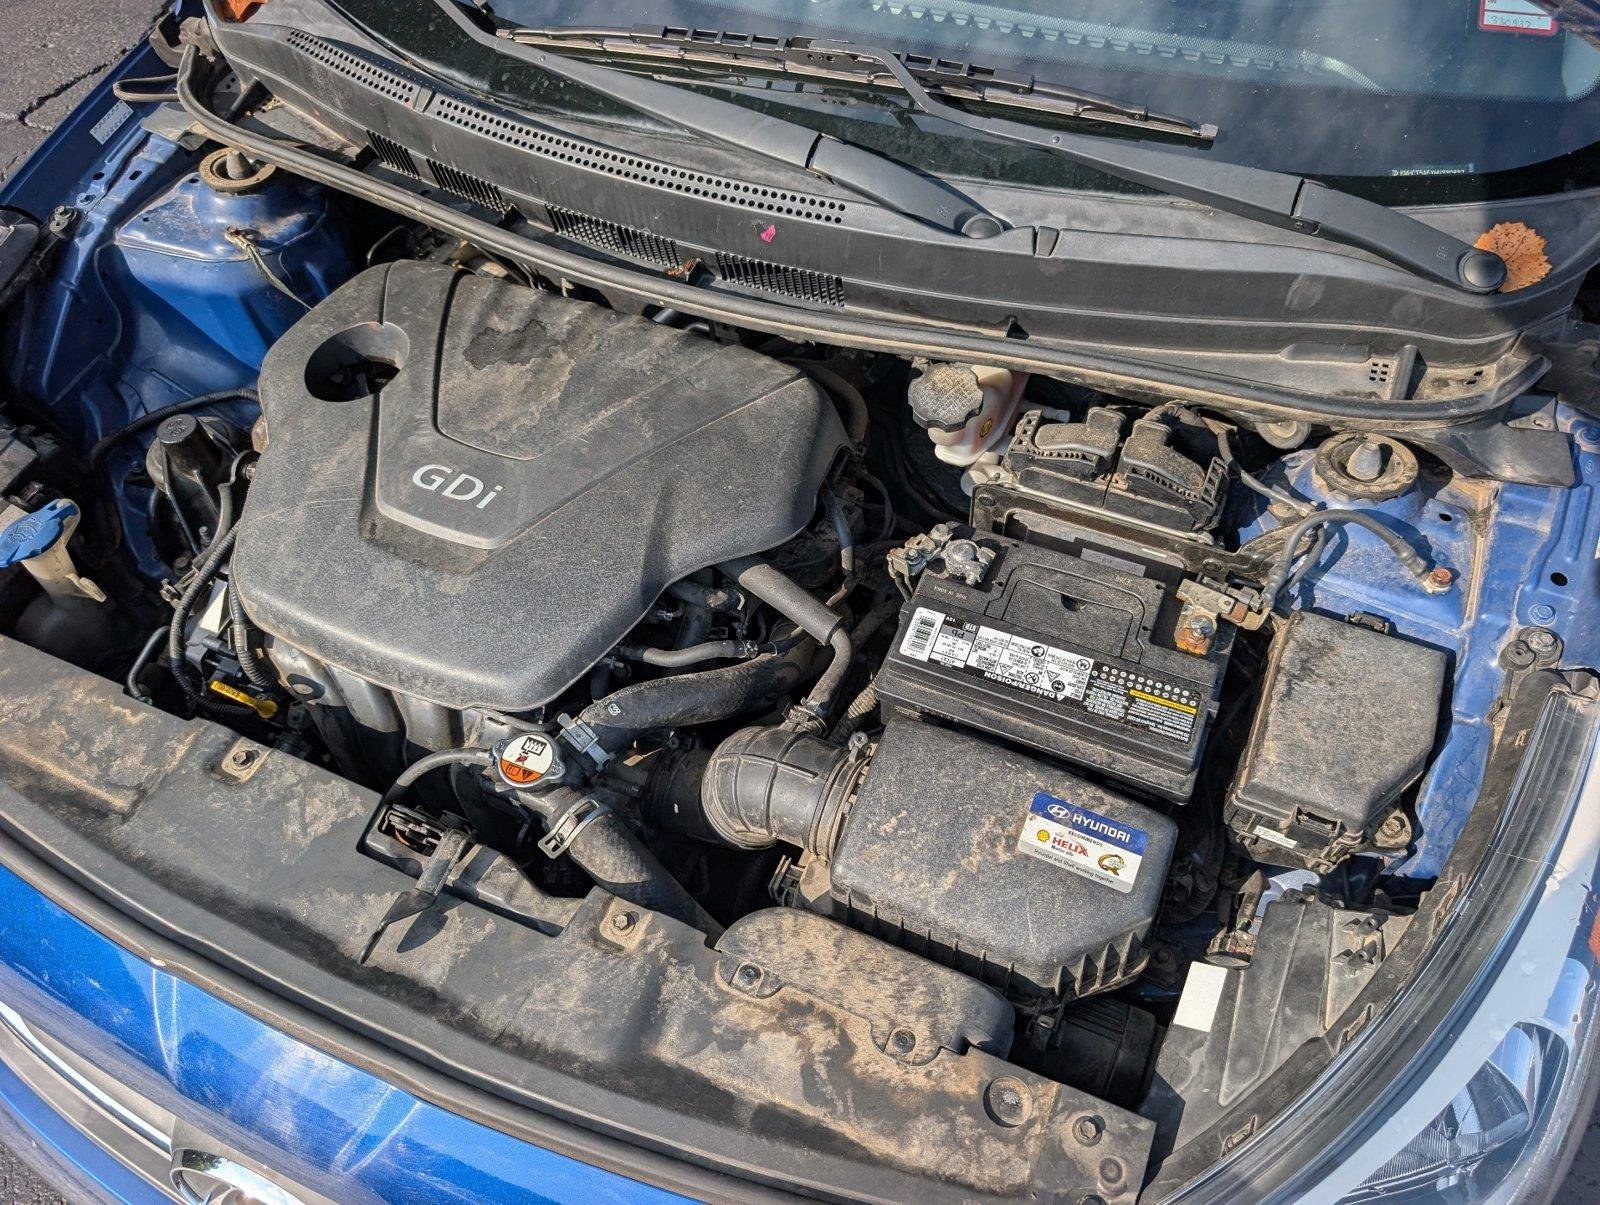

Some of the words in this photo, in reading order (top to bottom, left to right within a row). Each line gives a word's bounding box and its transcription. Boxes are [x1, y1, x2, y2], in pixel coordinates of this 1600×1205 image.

[412, 463, 504, 509] GDi
[951, 629, 965, 638] Pb
[984, 671, 1056, 698] DANGER/POISON
[1072, 813, 1131, 843] HYUNDAI
[1052, 836, 1089, 858] HELIX
